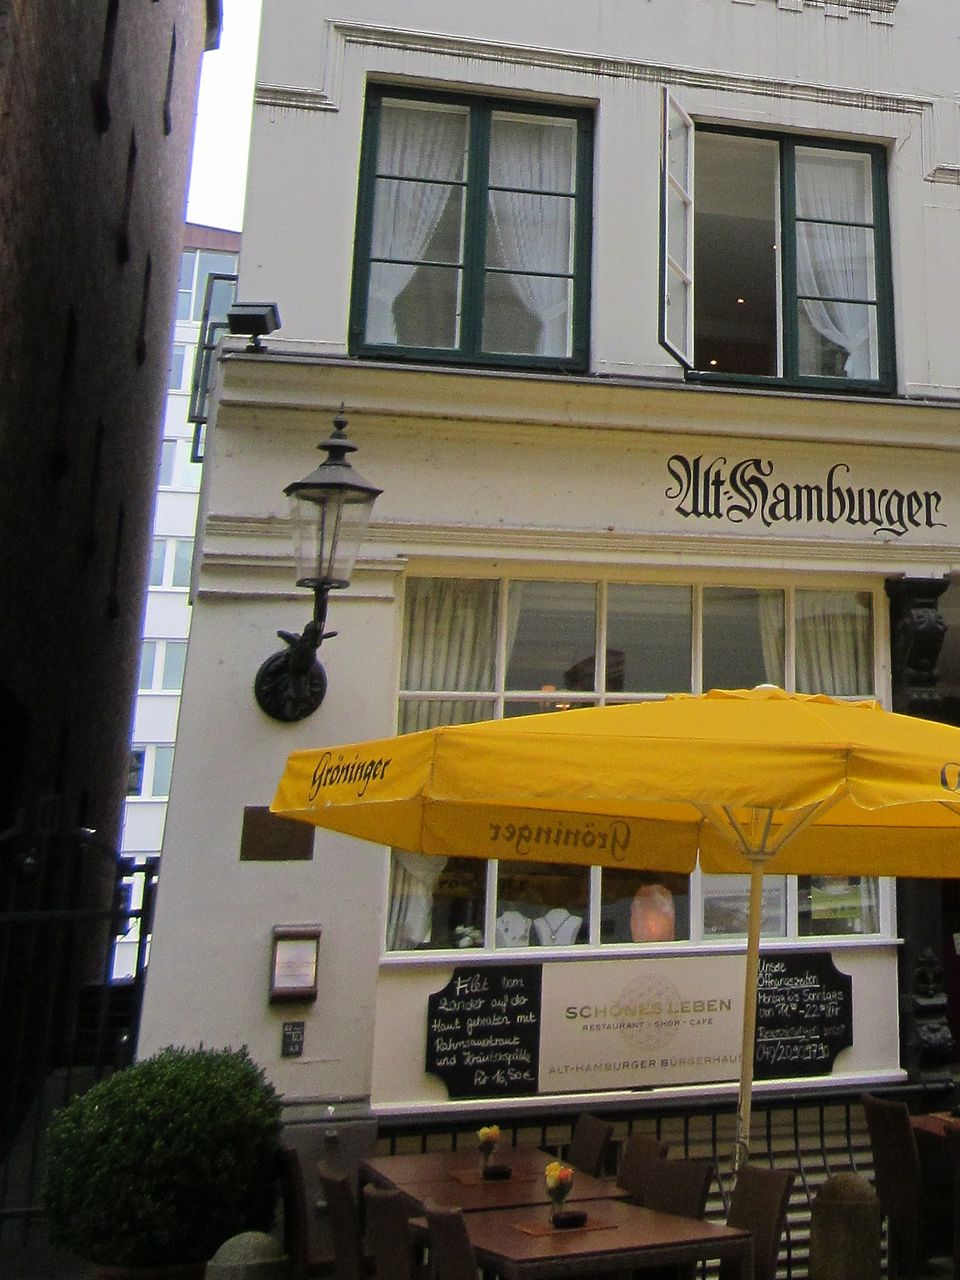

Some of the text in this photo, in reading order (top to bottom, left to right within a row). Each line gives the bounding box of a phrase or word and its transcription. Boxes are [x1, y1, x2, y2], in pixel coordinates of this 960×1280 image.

[309, 751, 393, 802] Gröninger
[565, 998, 732, 1019] SCHÖNES LEBEN
[582, 1021, 644, 1031] RESTAURANT
[549, 1059, 656, 1074] ALT-HAMBURGER
